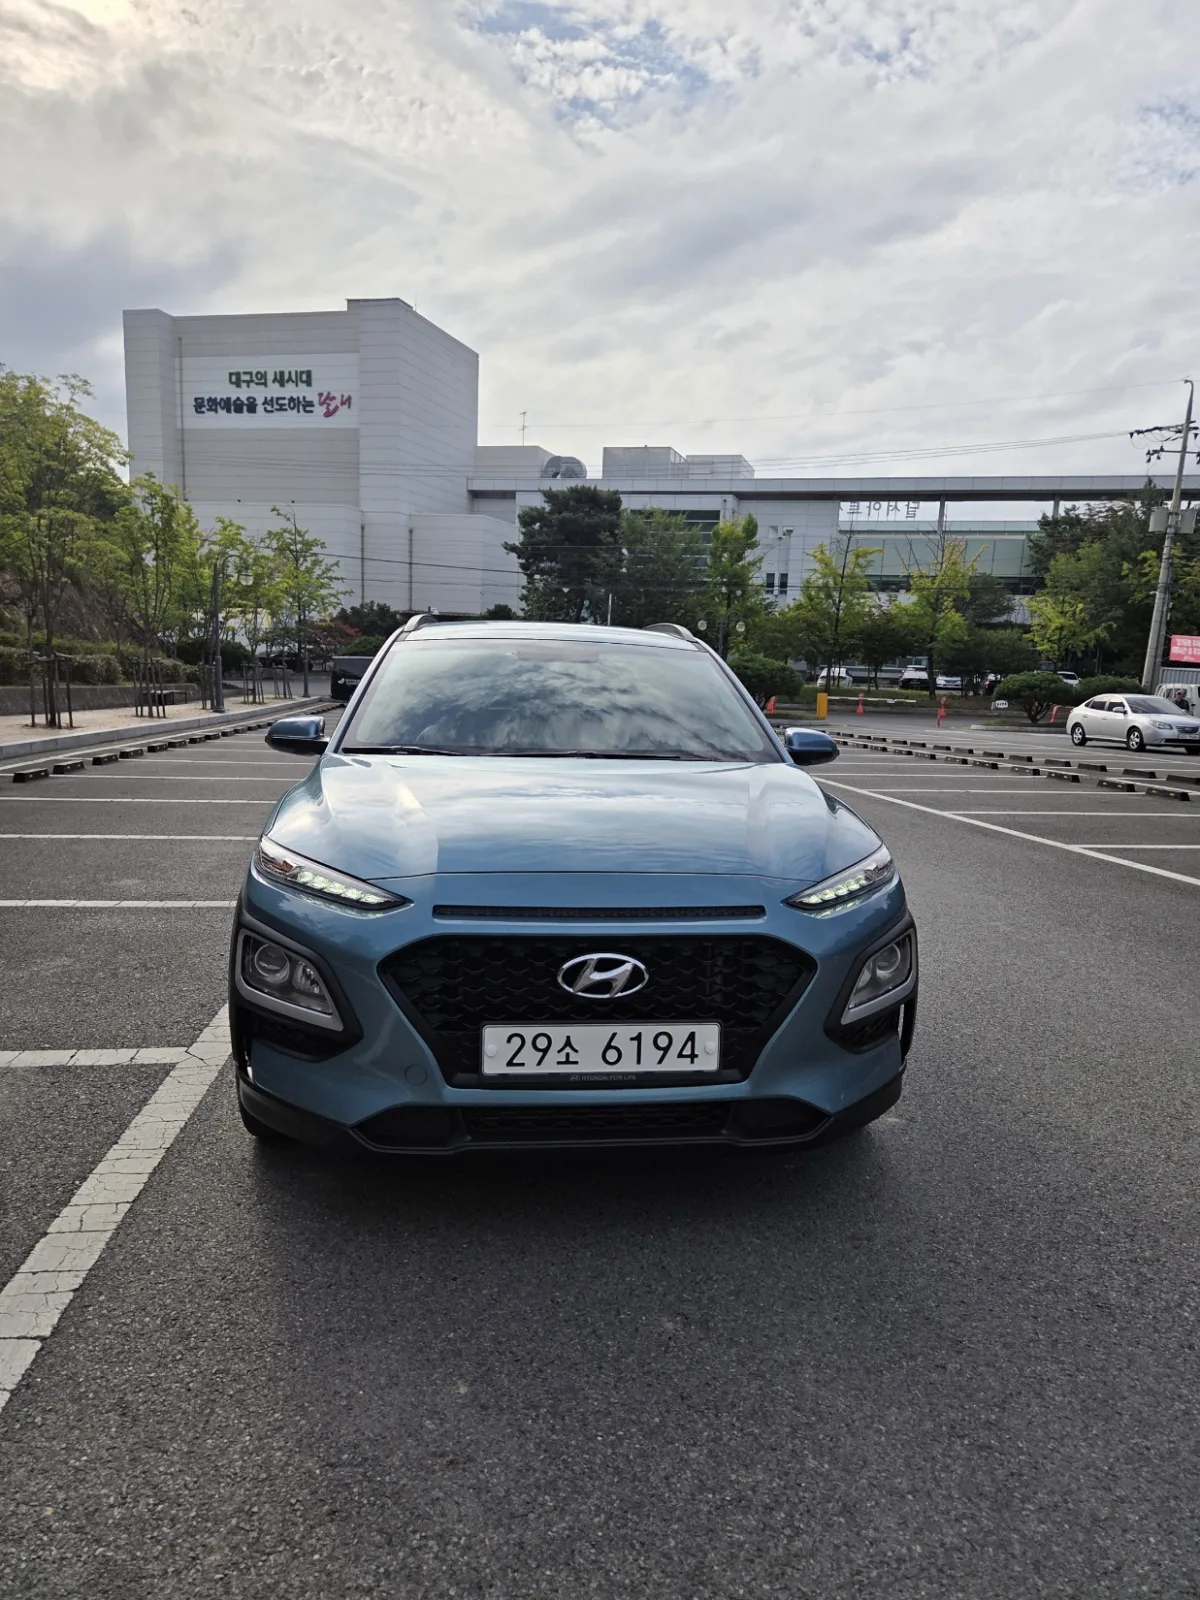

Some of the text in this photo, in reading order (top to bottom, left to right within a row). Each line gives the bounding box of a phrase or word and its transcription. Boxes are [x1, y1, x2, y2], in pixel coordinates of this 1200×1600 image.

[228, 369, 313, 388] 대구의 새시대
[193, 395, 259, 414] 문화예술을
[261, 395, 315, 414] 선도하는
[505, 1031, 699, 1067] 29소 6194
